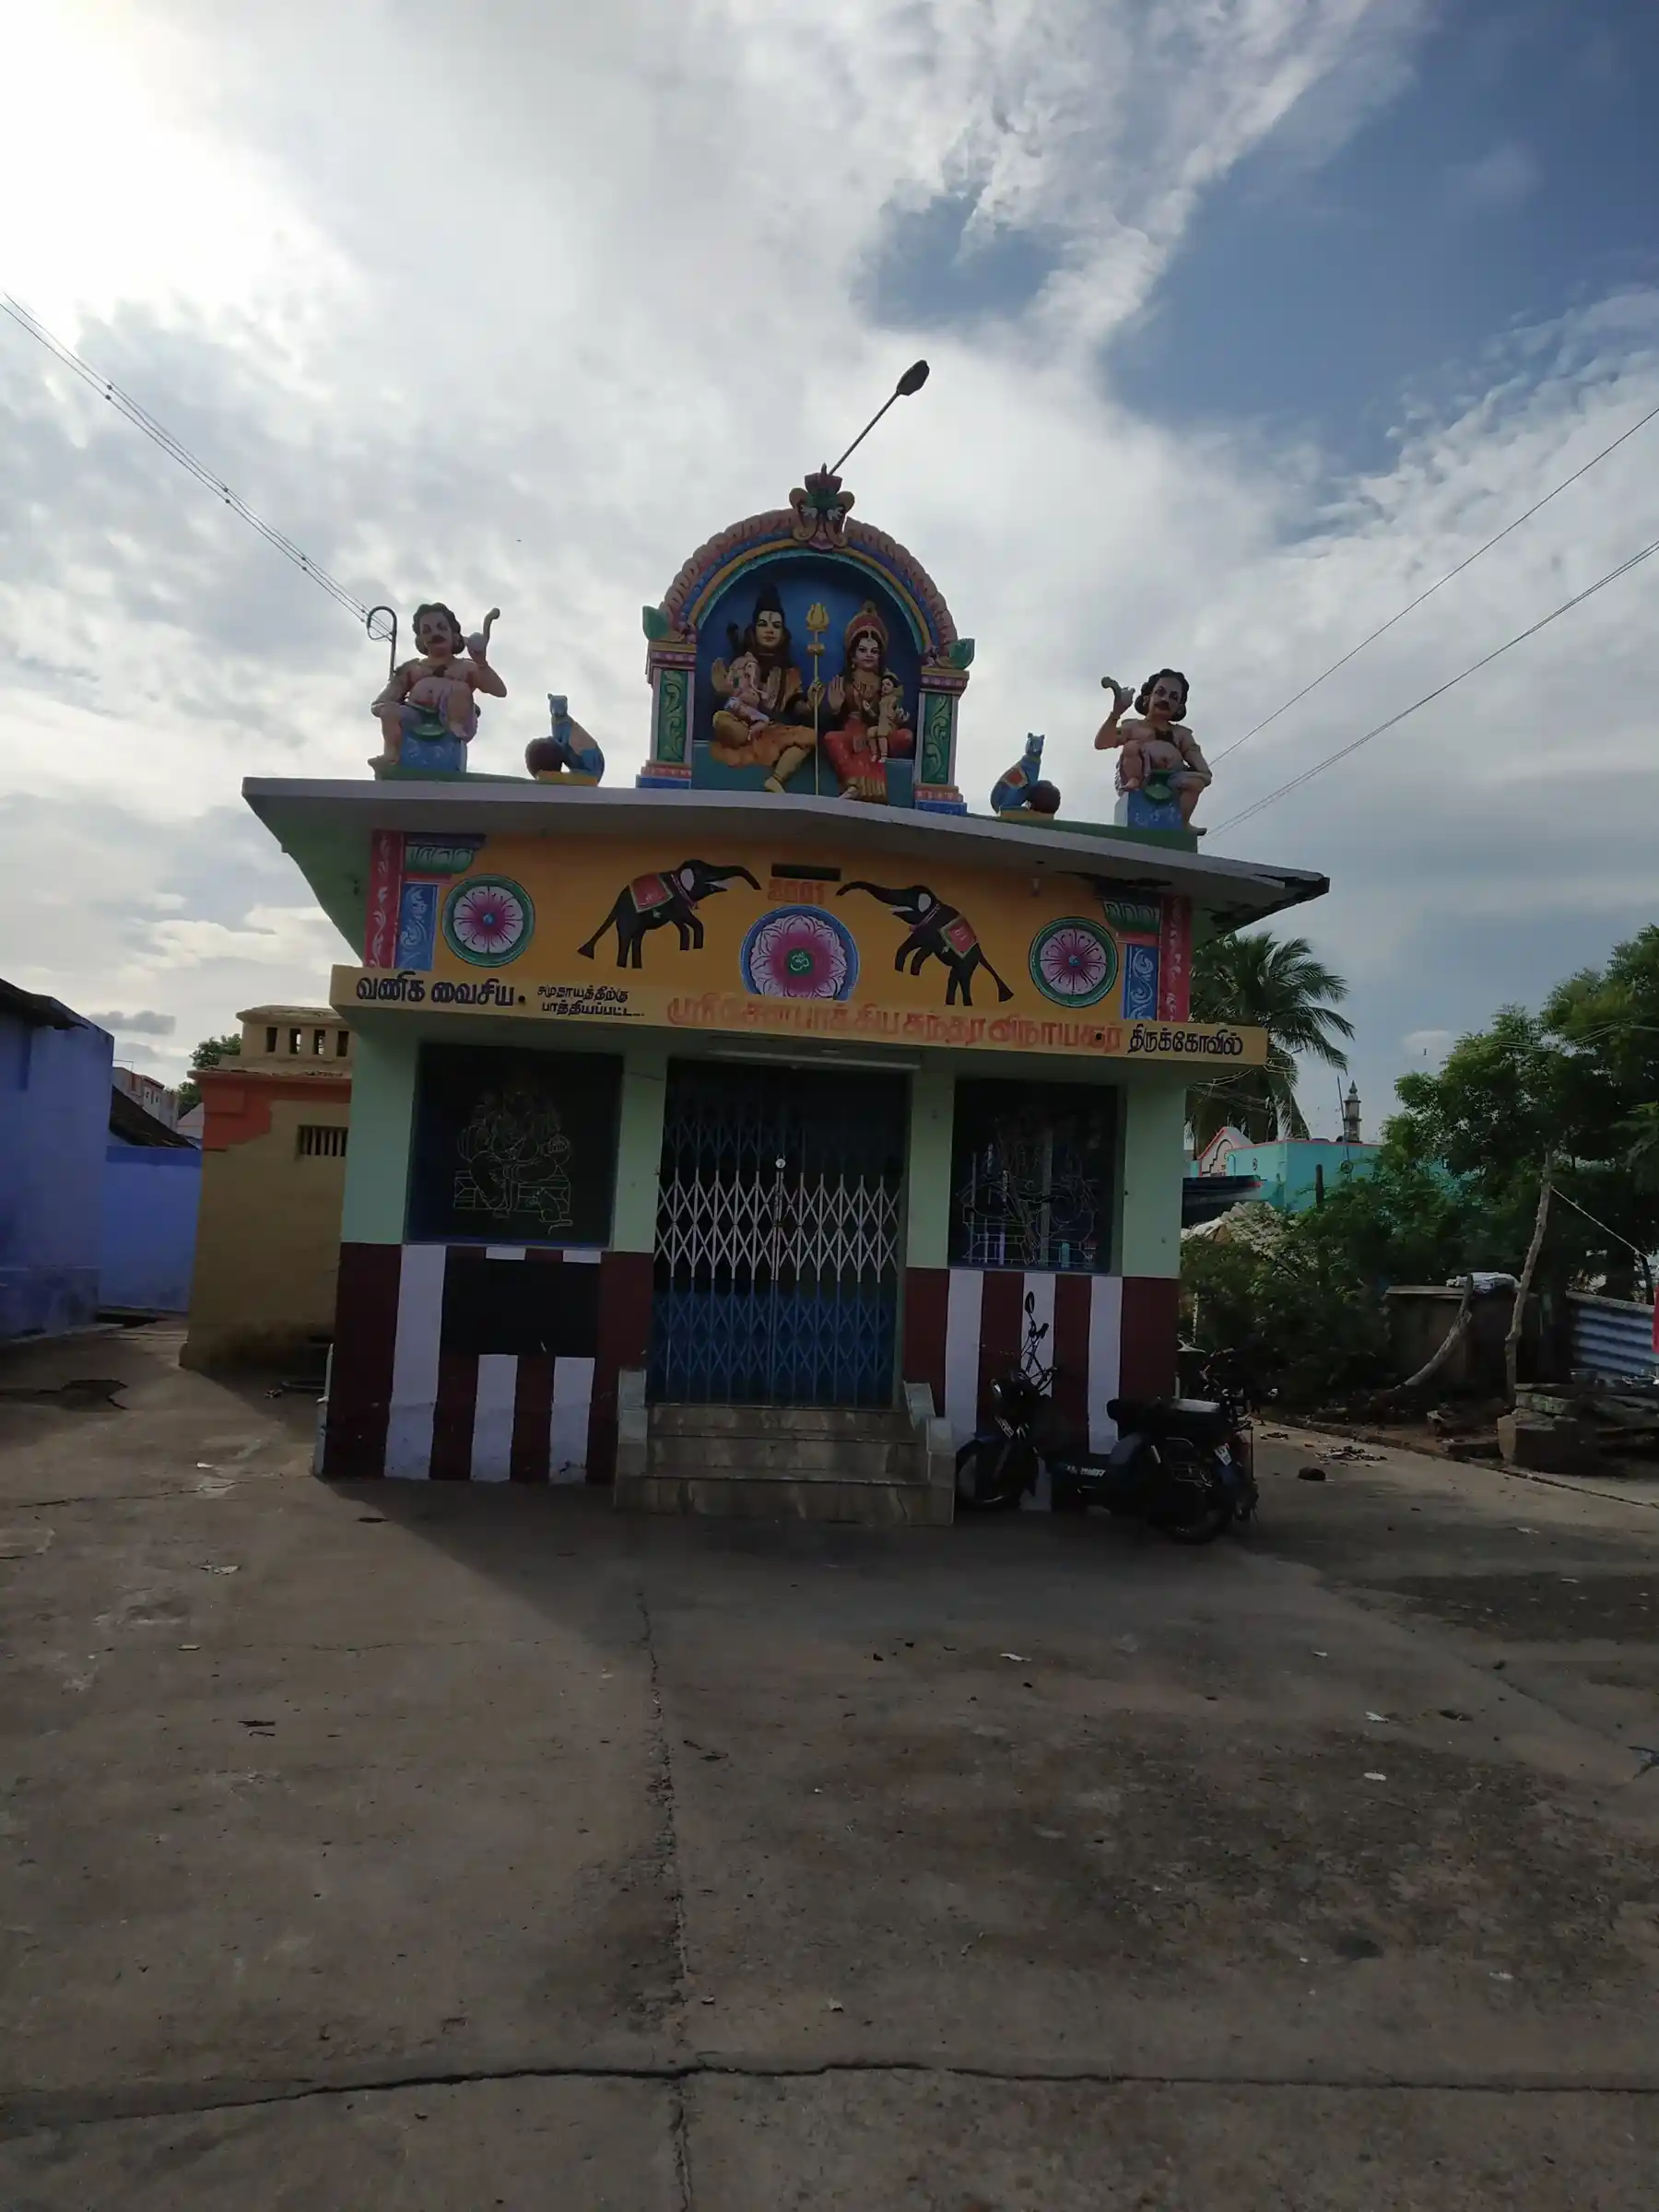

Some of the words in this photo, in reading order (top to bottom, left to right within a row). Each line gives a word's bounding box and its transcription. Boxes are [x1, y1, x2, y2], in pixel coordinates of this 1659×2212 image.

[356, 971, 426, 1002] வணிக
[431, 978, 514, 1006] வைசிய
[1127, 1023, 1243, 1055] திருக்கோவில்
